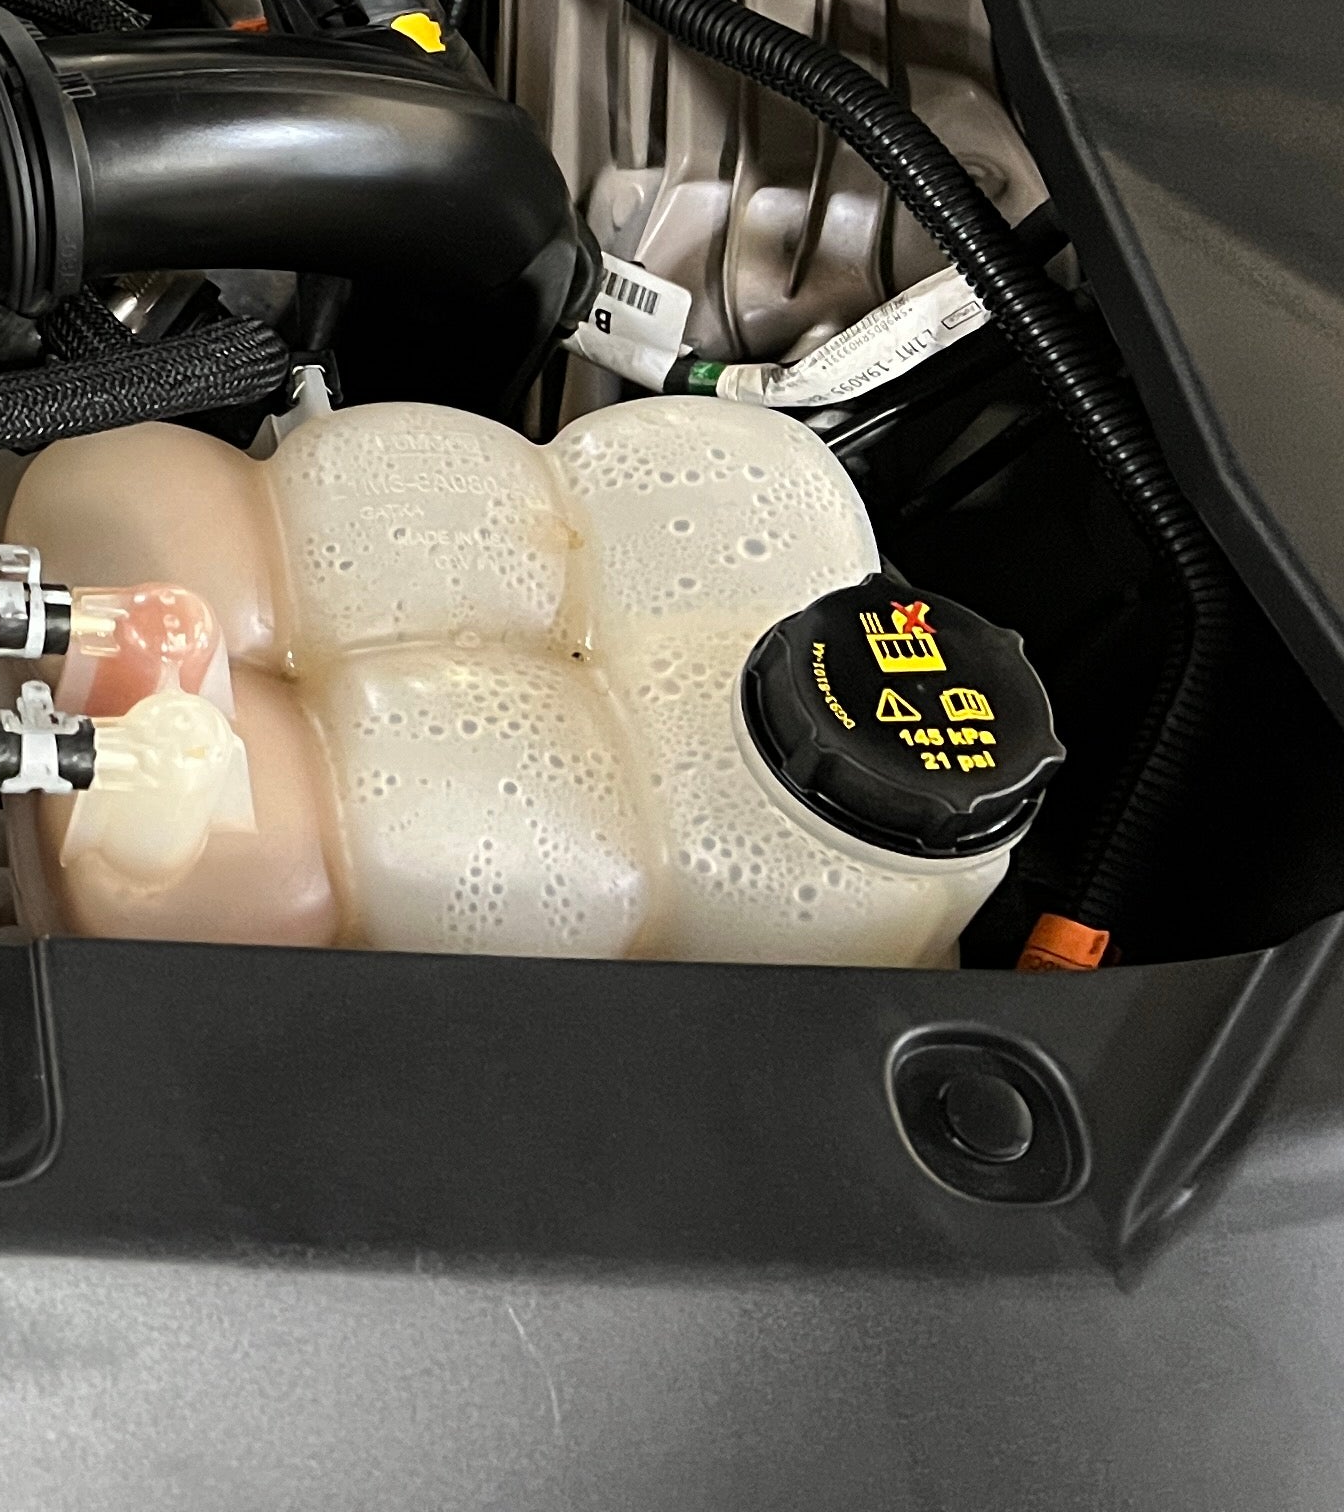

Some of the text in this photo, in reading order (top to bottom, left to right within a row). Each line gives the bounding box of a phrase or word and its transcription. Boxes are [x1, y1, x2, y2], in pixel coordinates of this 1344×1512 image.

[899, 727, 997, 747] 145 kPa
[920, 750, 996, 773] 21 psi
